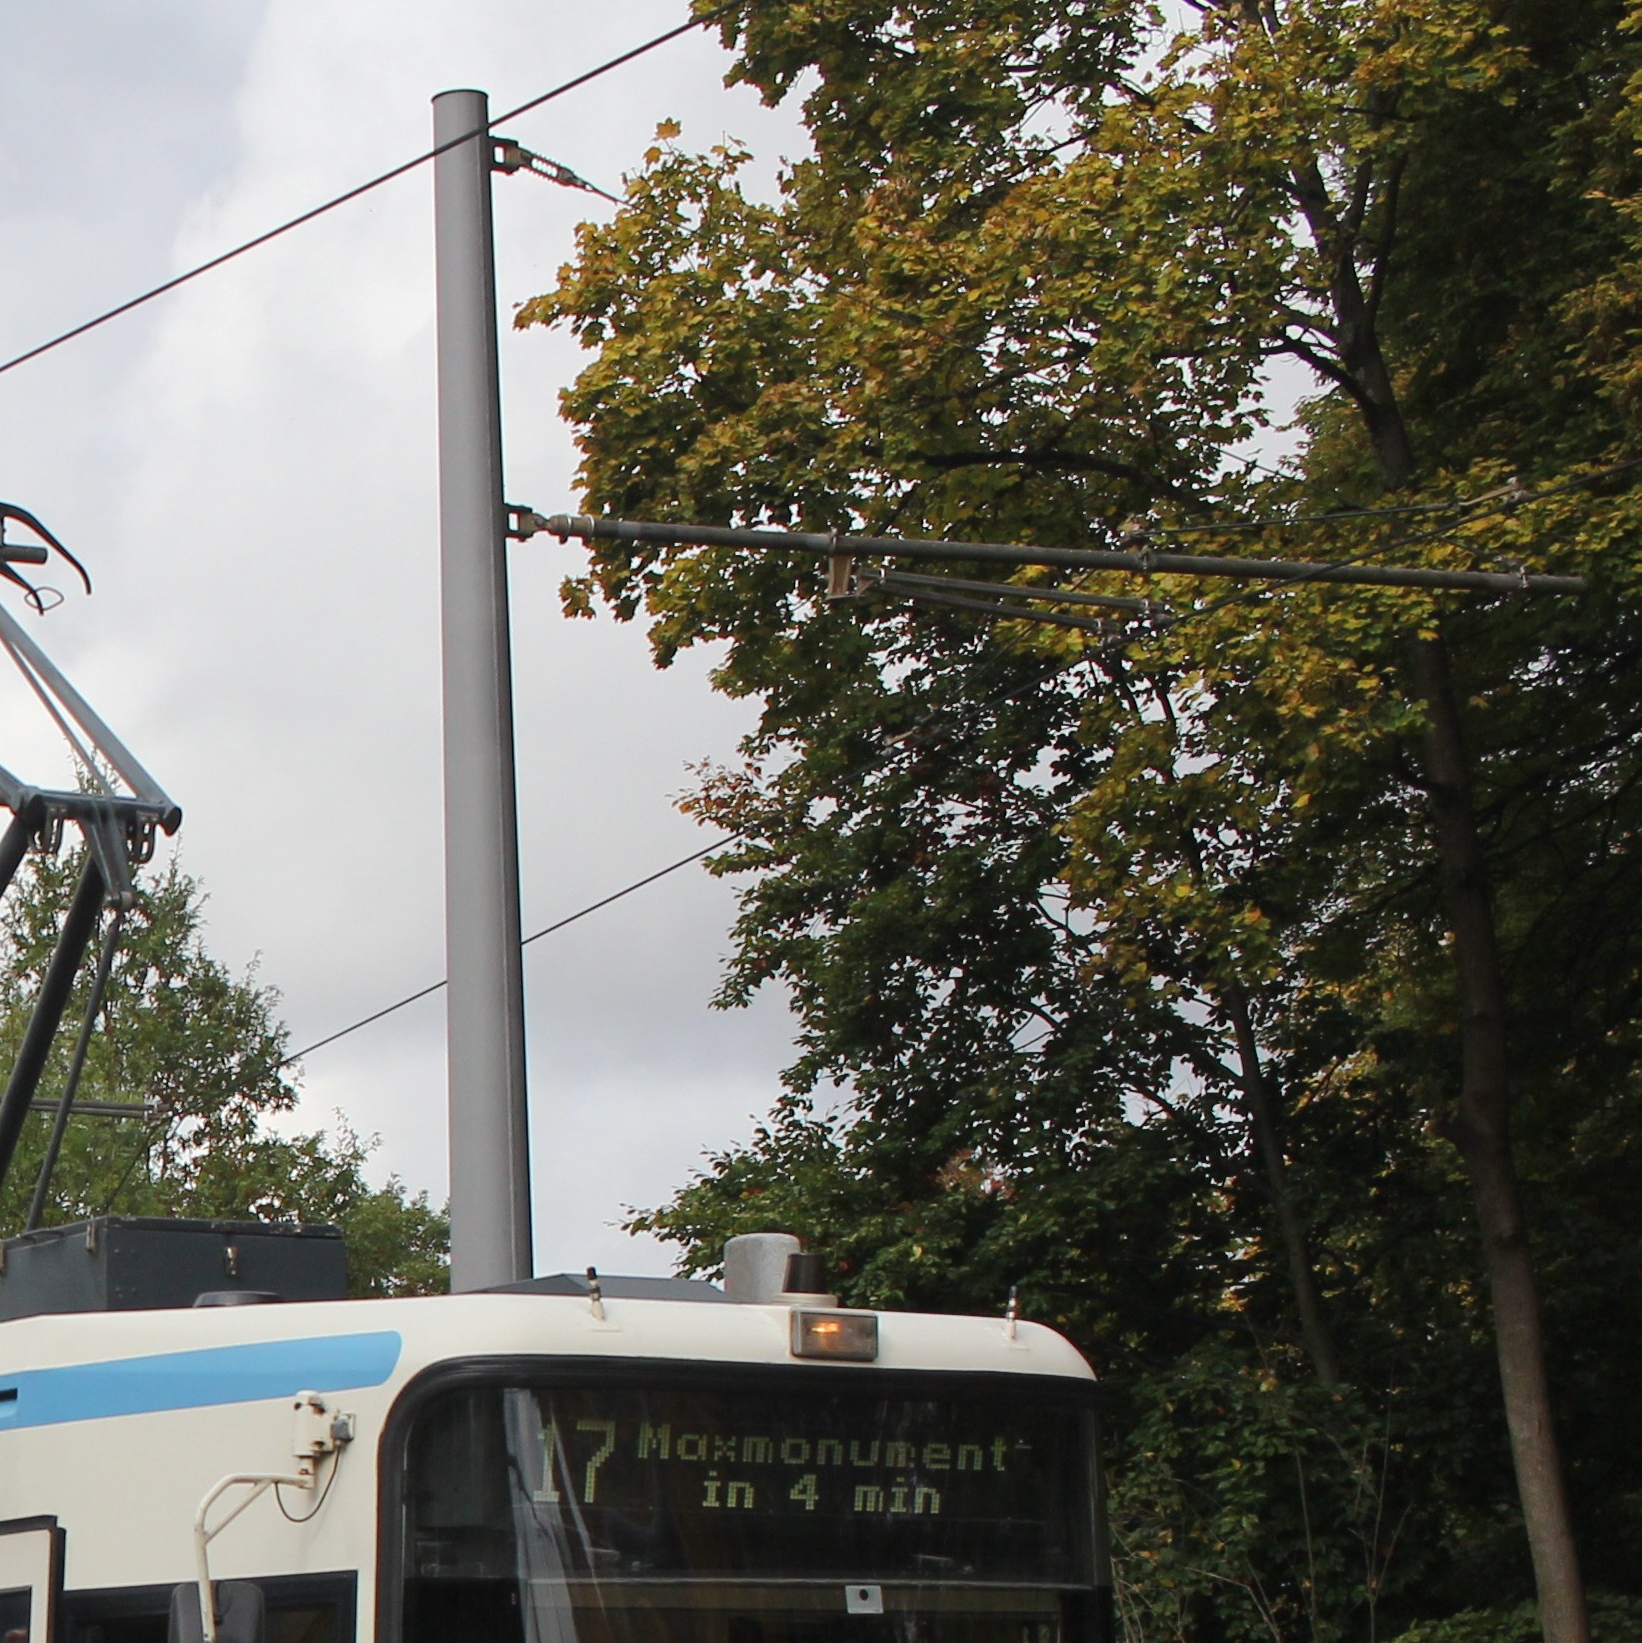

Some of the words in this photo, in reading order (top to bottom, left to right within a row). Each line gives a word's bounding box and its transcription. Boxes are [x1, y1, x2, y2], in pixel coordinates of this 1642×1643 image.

[533, 1420, 615, 1503] 17
[638, 1422, 1008, 1472] Maxmonument
[702, 1470, 754, 1509] in
[790, 1474, 819, 1510] 4
[853, 1477, 941, 1514] min
